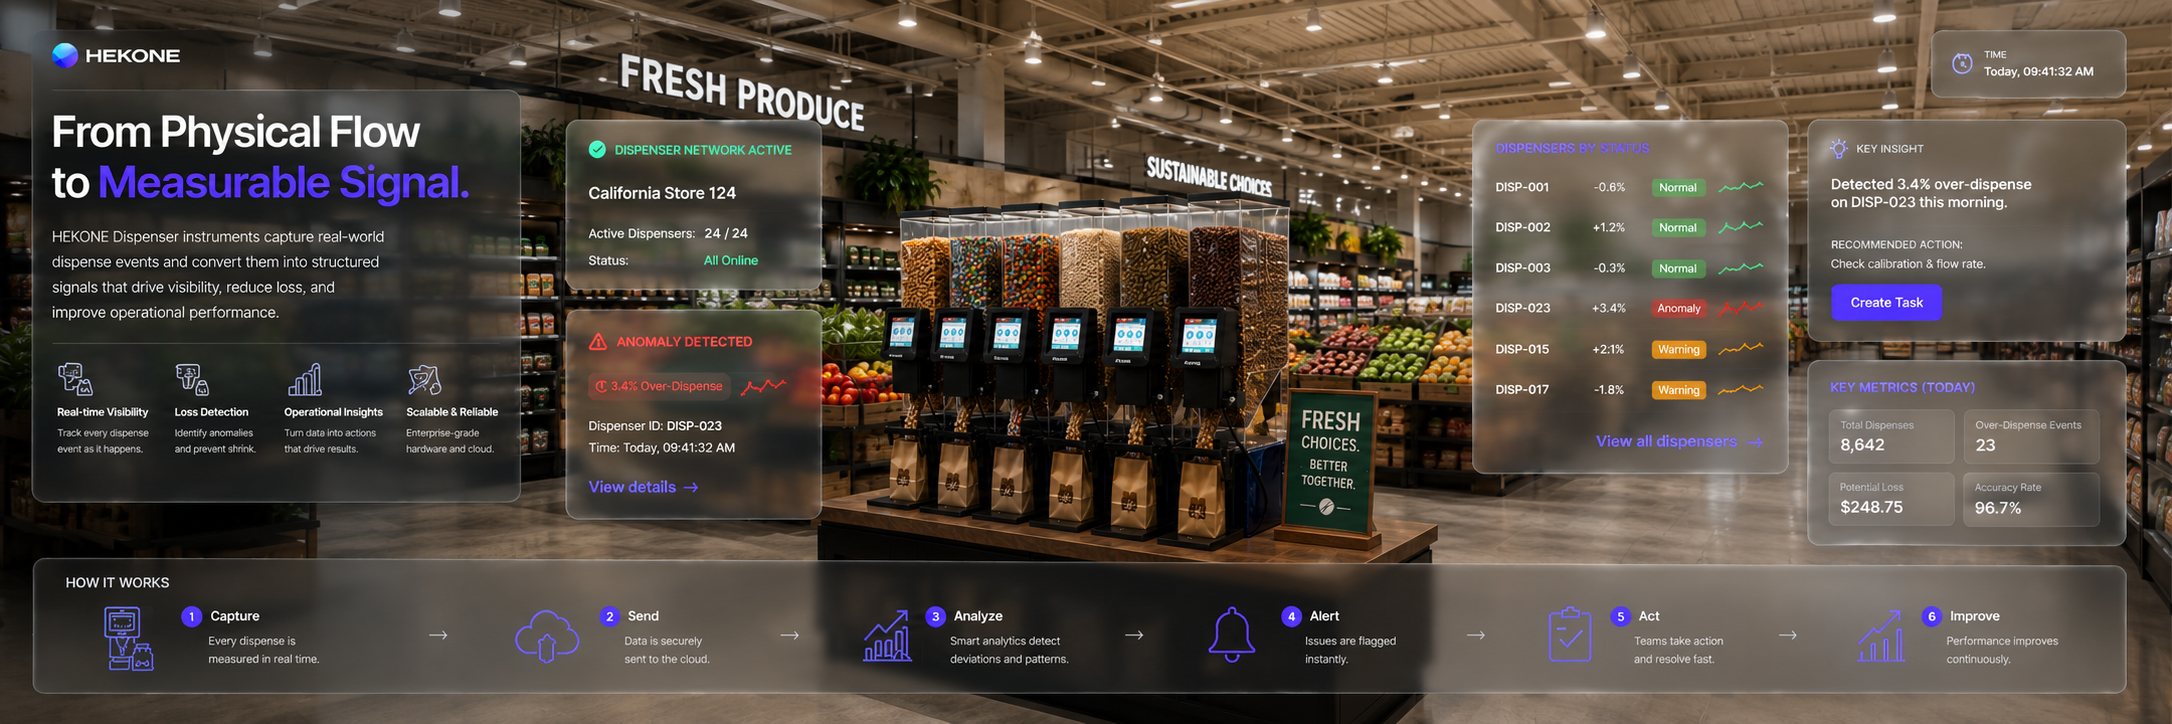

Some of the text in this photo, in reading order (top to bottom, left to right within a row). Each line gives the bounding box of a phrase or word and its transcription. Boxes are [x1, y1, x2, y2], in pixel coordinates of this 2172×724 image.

[620, 53, 865, 132] FRESH PRODUCE
[1147, 155, 1272, 197] SUSTAINABLE CHOICES
[1302, 409, 1360, 432] FRESH
[1301, 435, 1360, 452] CHOICES.
[1309, 459, 1348, 472] BETTER
[1301, 474, 1356, 490] TOGETHER.
